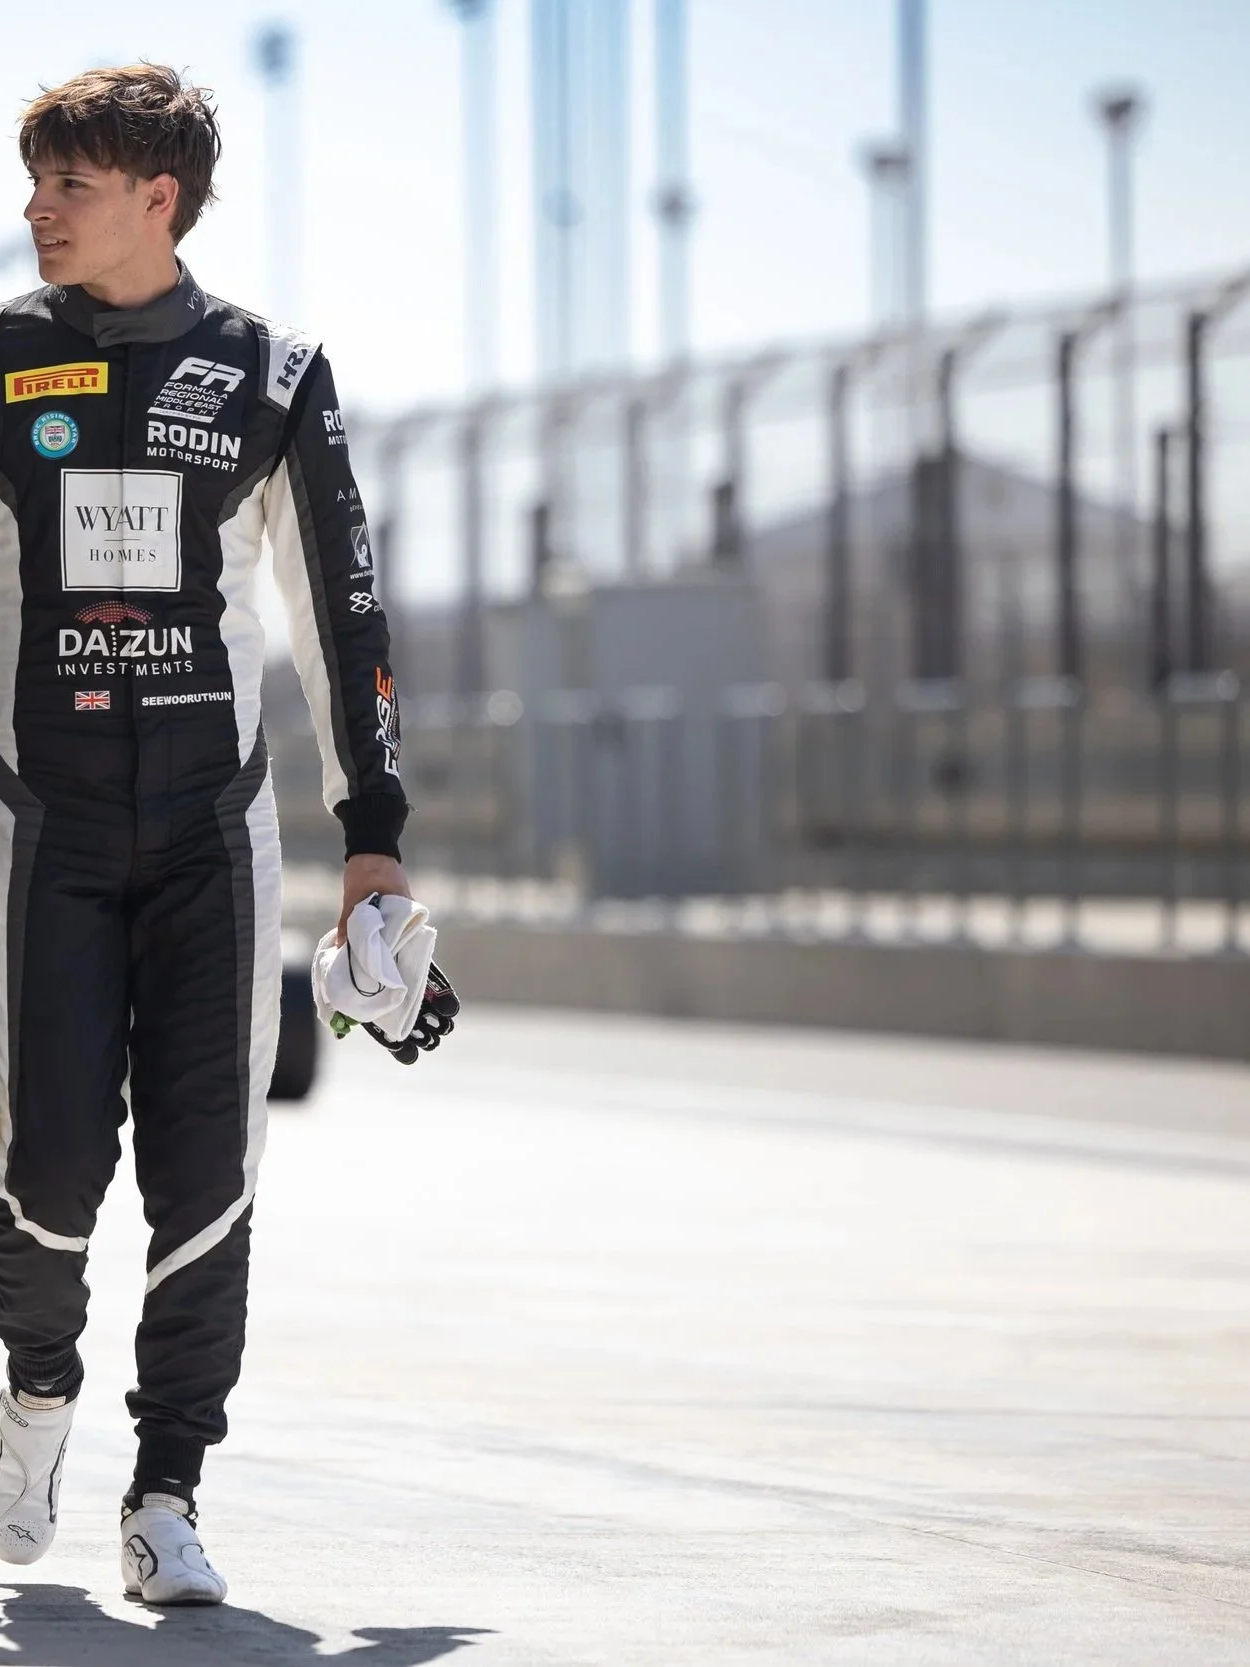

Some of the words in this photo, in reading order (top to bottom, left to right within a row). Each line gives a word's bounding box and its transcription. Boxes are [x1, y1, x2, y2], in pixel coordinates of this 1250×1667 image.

[13, 368, 99, 396] PIRELLI
[169, 357, 246, 392] FR
[159, 388, 224, 405] REGIONAL
[163, 381, 228, 399] FORMULA
[153, 401, 219, 416] TROPHY
[155, 395, 194, 407] MIDDLE
[193, 401, 223, 411] EAST
[41, 413, 70, 422] RISING
[69, 423, 78, 443] STAR
[147, 420, 242, 459] RODIN
[146, 447, 238, 472] MOTORSPORT
[74, 505, 169, 532] WYATT
[90, 548, 157, 562] HOMES
[57, 660, 193, 676] INVESTMENTS
[141, 691, 232, 707] SEEWOORUTHUN
